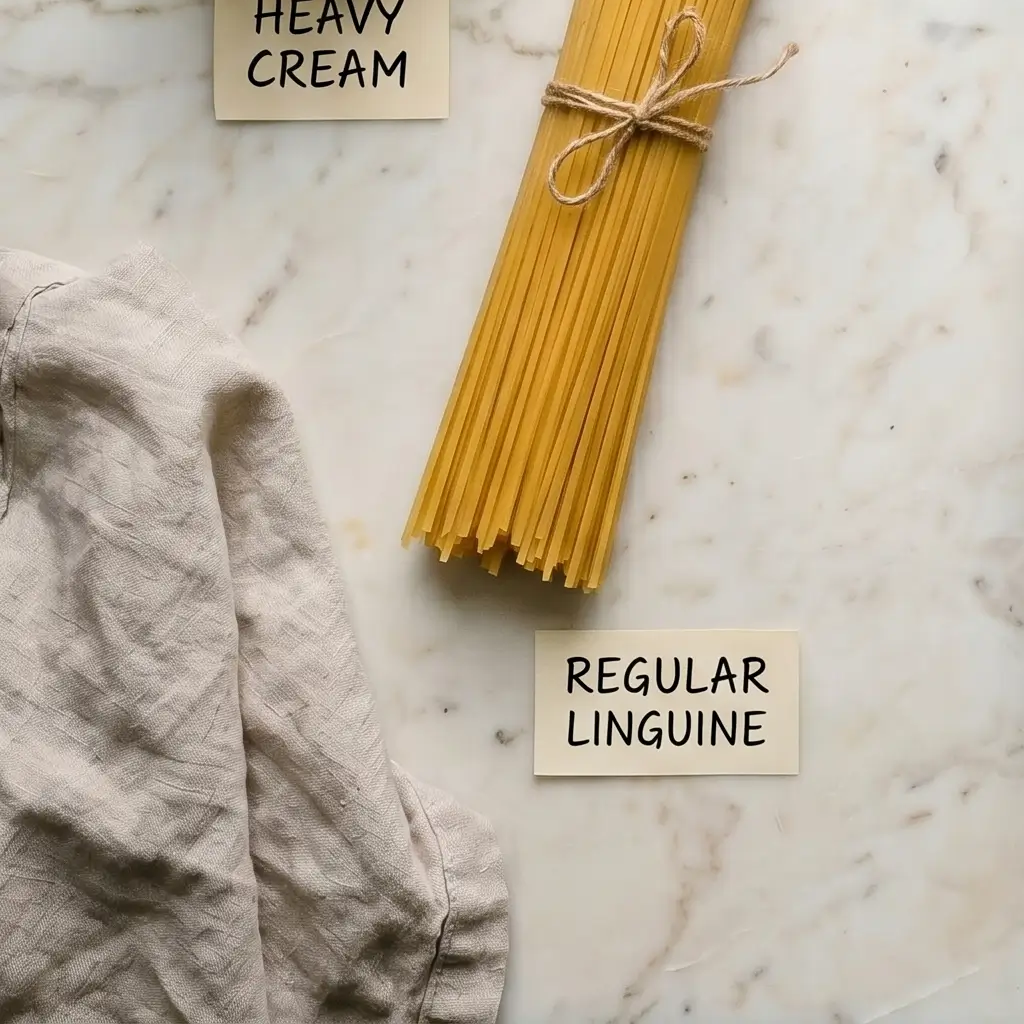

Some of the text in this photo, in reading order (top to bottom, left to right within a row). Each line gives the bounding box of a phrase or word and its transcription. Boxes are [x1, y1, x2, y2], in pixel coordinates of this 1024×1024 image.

[247, 48, 408, 89] CREAM
[566, 656, 770, 697] REGULAR
[567, 710, 767, 750] LINGUINE
